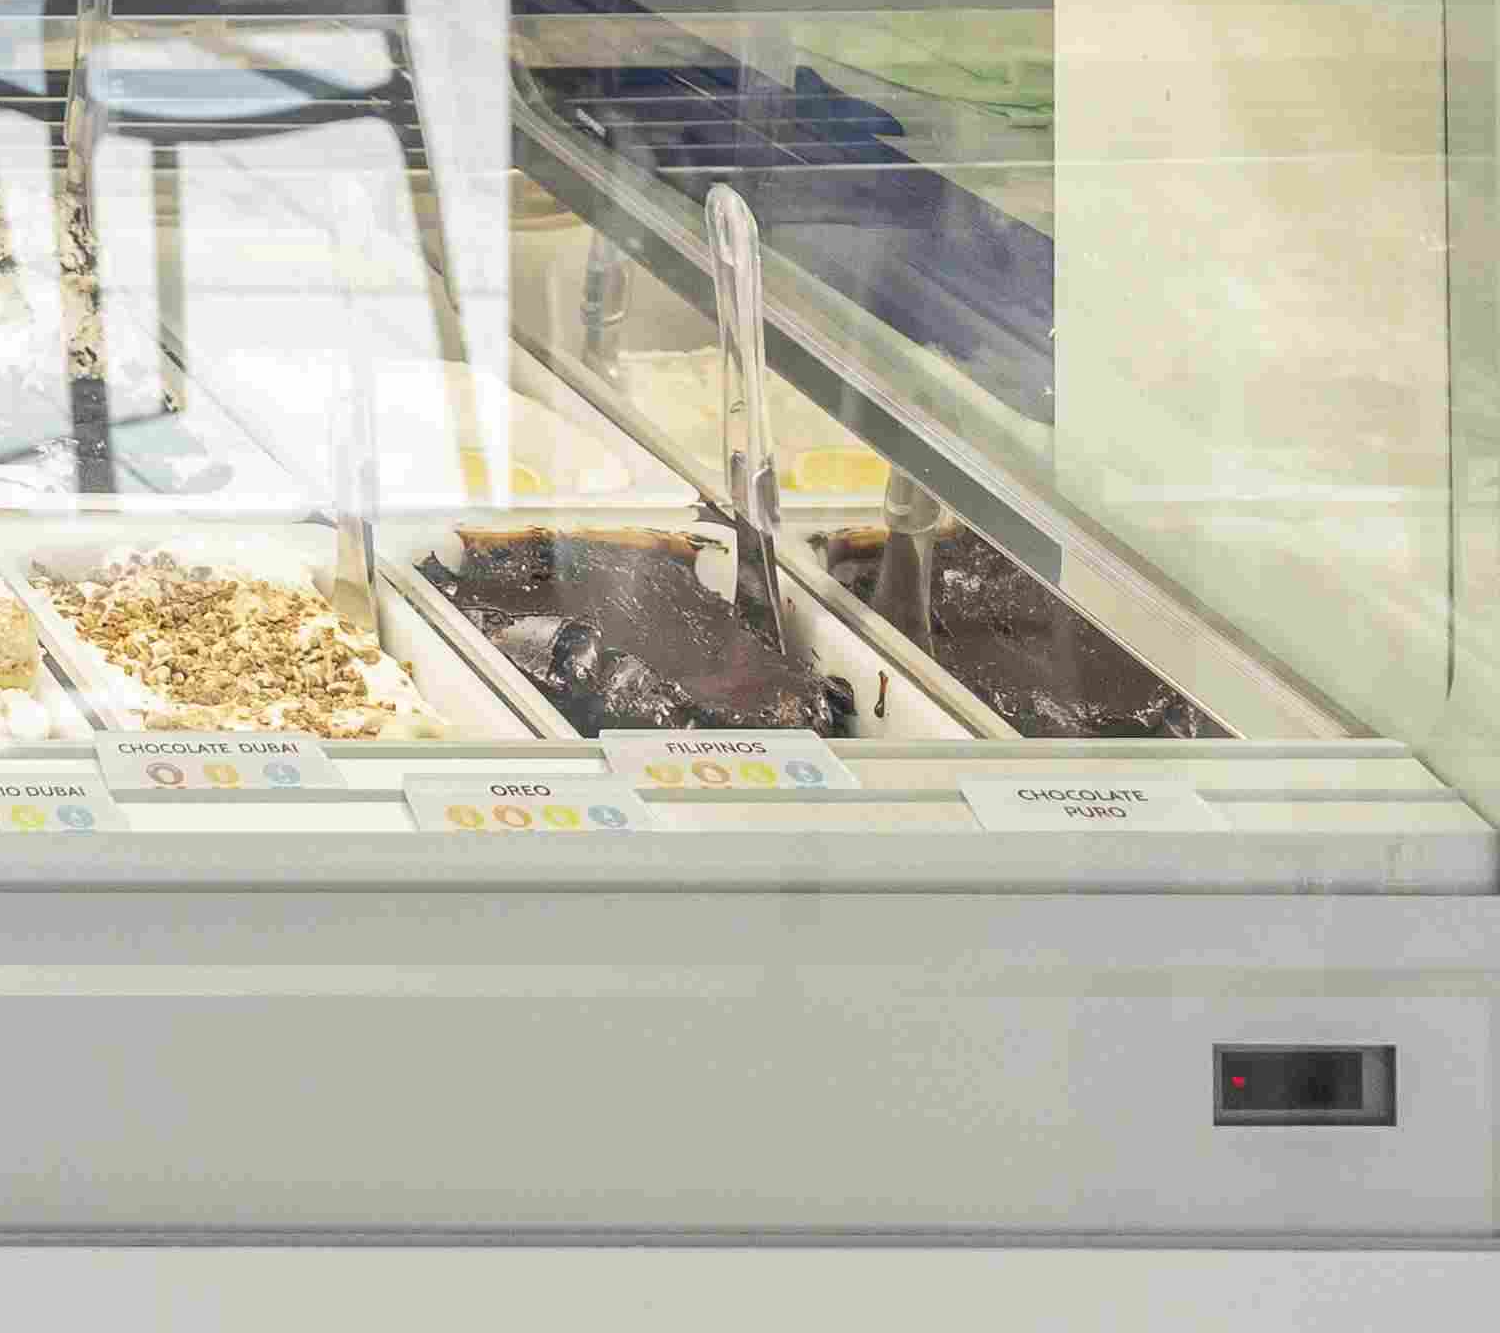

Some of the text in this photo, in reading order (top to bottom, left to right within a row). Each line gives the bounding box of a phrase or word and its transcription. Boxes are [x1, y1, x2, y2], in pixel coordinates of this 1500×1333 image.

[117, 741, 300, 755] CHOCOLATE DUBAI
[665, 741, 768, 755] FILIPINOS
[25, 785, 88, 798] DUBAI
[490, 784, 552, 797] OREO
[1017, 788, 1149, 803] CHOCOLATE
[1063, 805, 1128, 819] PURO
